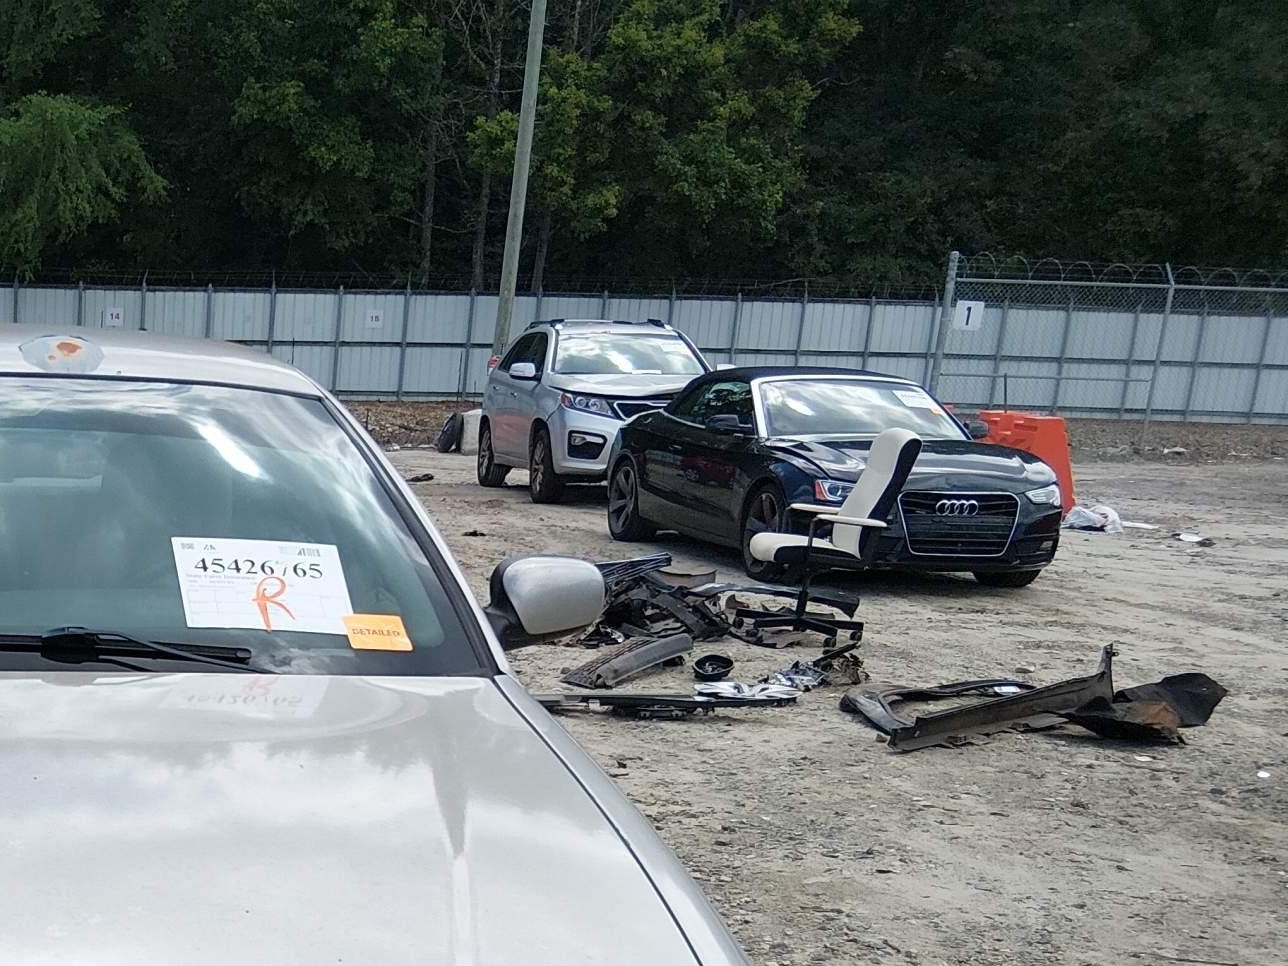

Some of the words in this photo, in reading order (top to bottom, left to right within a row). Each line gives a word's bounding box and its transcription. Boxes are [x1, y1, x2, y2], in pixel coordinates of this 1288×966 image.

[110, 312, 120, 321] 14
[965, 306, 972, 326] 1
[252, 576, 296, 633] R
[352, 628, 400, 637] DETAILED
